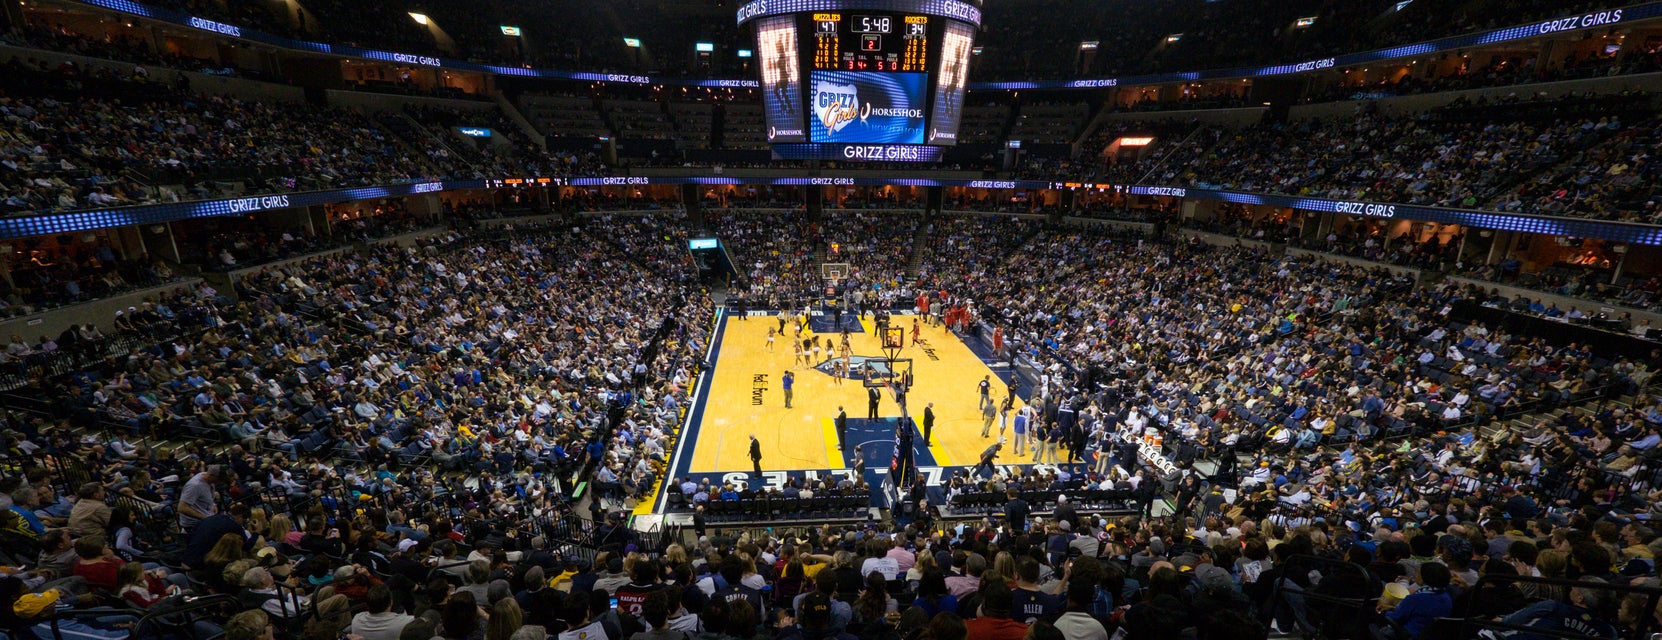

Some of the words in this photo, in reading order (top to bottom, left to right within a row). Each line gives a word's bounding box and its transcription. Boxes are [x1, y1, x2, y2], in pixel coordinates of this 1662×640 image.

[746, 1, 766, 17] GIRLS
[944, 0, 969, 18] GRIZZ
[191, 16, 217, 32] GRIZZ
[822, 22, 834, 31] 47
[863, 18, 890, 32] 5:48
[1540, 17, 1579, 33] GRIZZ
[1582, 10, 1622, 27] GIRLS
[912, 24, 924, 34] 34
[868, 41, 873, 50] 2
[394, 53, 418, 64] GRIZZ
[420, 56, 440, 67] GIRLS
[849, 61, 853, 69] 3
[878, 62, 883, 70] 5
[891, 62, 897, 70] 0
[1316, 57, 1334, 69] GIRLS
[609, 74, 629, 82] GRIZZ
[630, 75, 649, 83] GIRLS
[1098, 79, 1116, 87] GIRLS
[819, 91, 855, 108] GRIZZ
[824, 101, 858, 137] Girls
[872, 108, 922, 118] HORSESHOE
[844, 146, 883, 158] GRIZZ
[886, 147, 918, 159] GIRLS
[971, 180, 993, 188] GRIZZ
[994, 181, 1015, 189] GIRLS
[1148, 186, 1171, 195] GRIZZ
[229, 198, 261, 213] GRIZZ
[262, 194, 290, 209] GIRLS
[1336, 201, 1364, 215] GRIZZ
[1365, 203, 1395, 218] GIRLS
[1023, 603, 1043, 615] ALLEN
